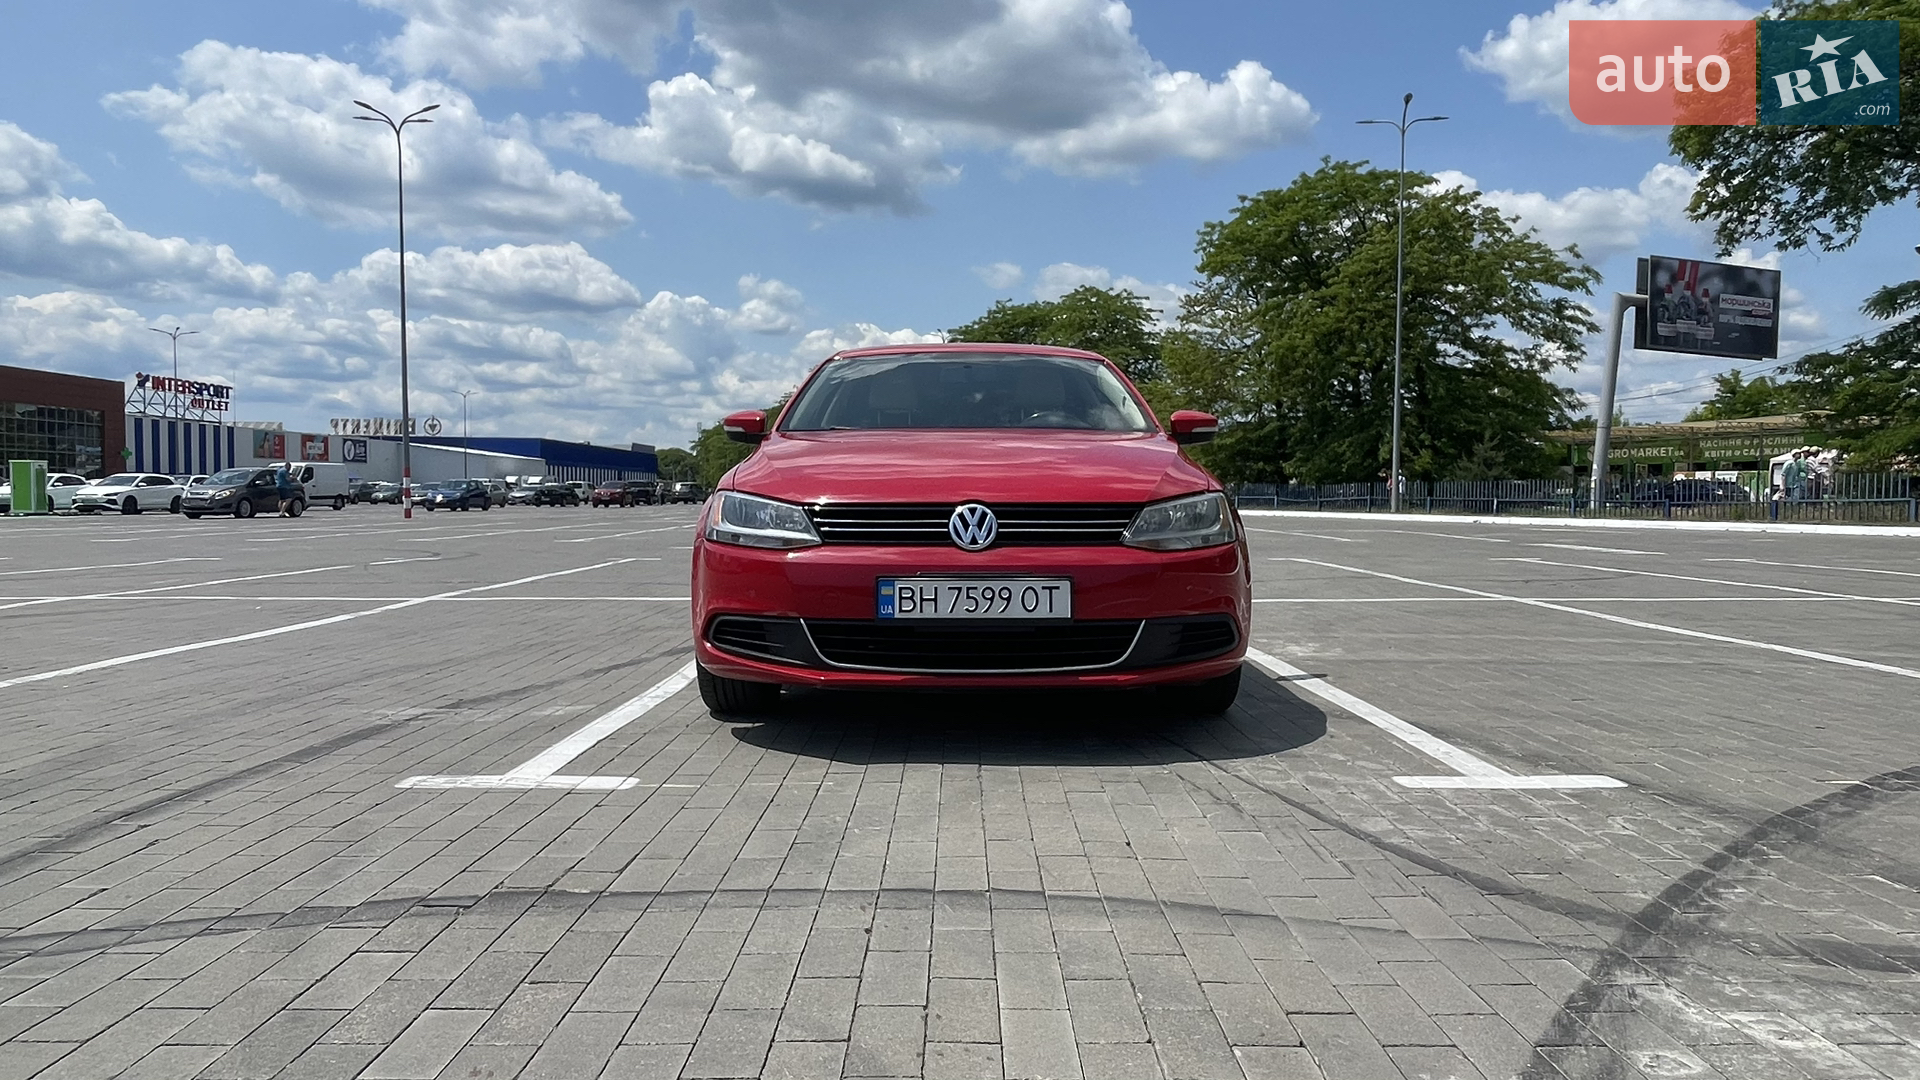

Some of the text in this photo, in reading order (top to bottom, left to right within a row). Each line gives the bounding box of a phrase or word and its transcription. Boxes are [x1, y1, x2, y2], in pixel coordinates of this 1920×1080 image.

[151, 376, 233, 399] INTERSPORT
[190, 397, 230, 411] OUTLET
[1704, 449, 1732, 458] КВІТИ
[898, 585, 1061, 614] BH 7599 OT
[880, 604, 894, 614] UA
